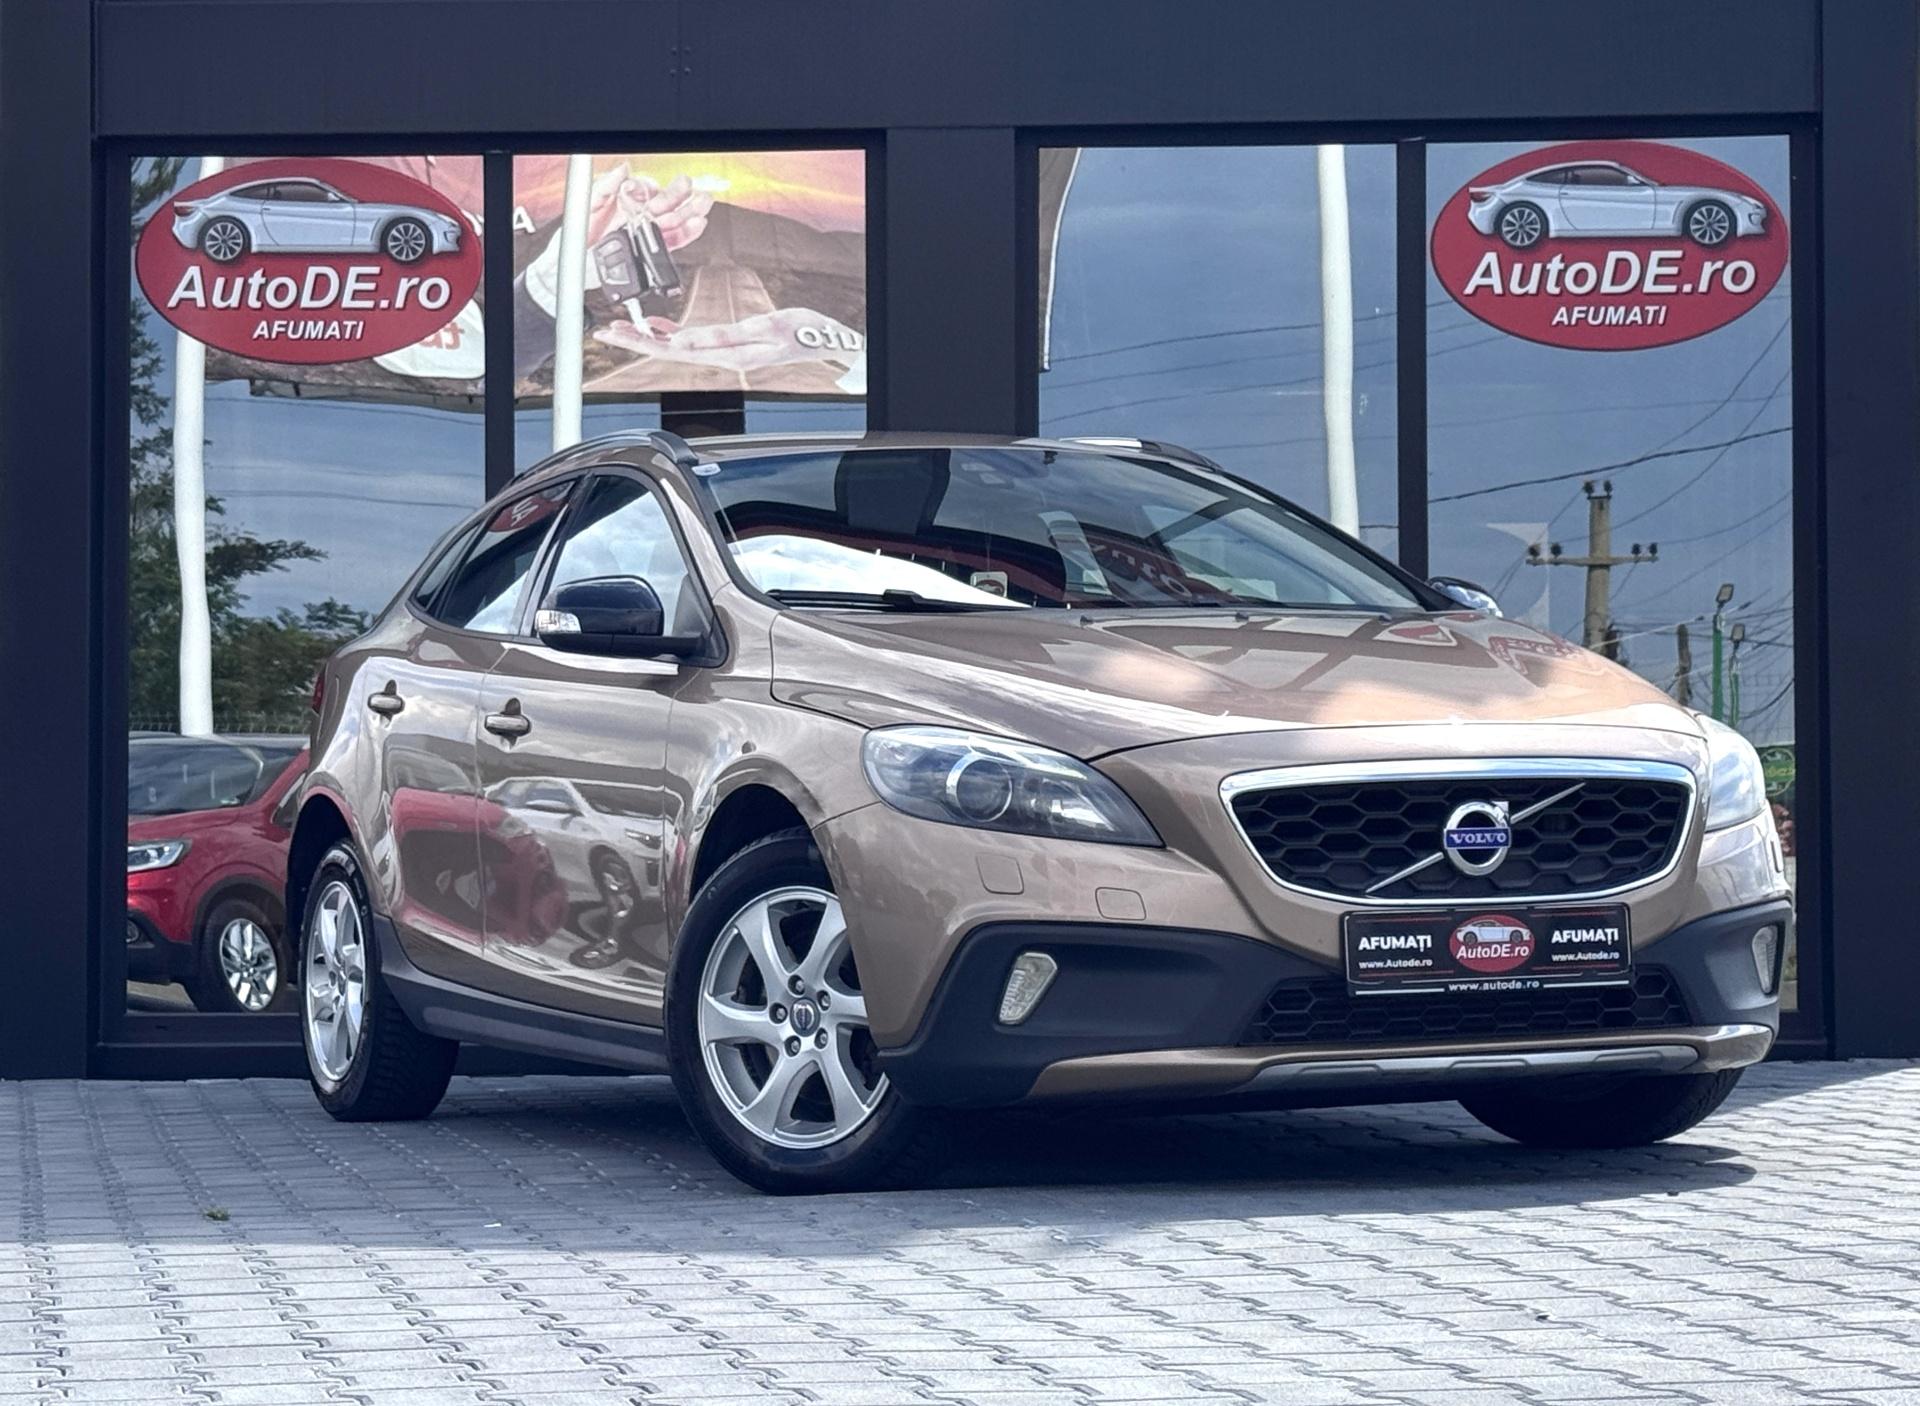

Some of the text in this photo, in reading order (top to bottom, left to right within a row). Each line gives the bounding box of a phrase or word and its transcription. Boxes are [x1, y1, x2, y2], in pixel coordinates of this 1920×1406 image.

[1463, 249, 1756, 295] AutoDE.ro
[166, 265, 451, 310] AutoDE.ro
[1552, 305, 1668, 326] AFUMATI
[253, 320, 364, 340] AFUMATI
[1450, 832, 1507, 844] VOLVO
[1456, 944, 1529, 960] AutoDE.ro
[1551, 951, 1620, 962] www.Autode.ro
[1358, 958, 1433, 969] www.Autode.ro
[1448, 980, 1540, 992] www.autode.ro
